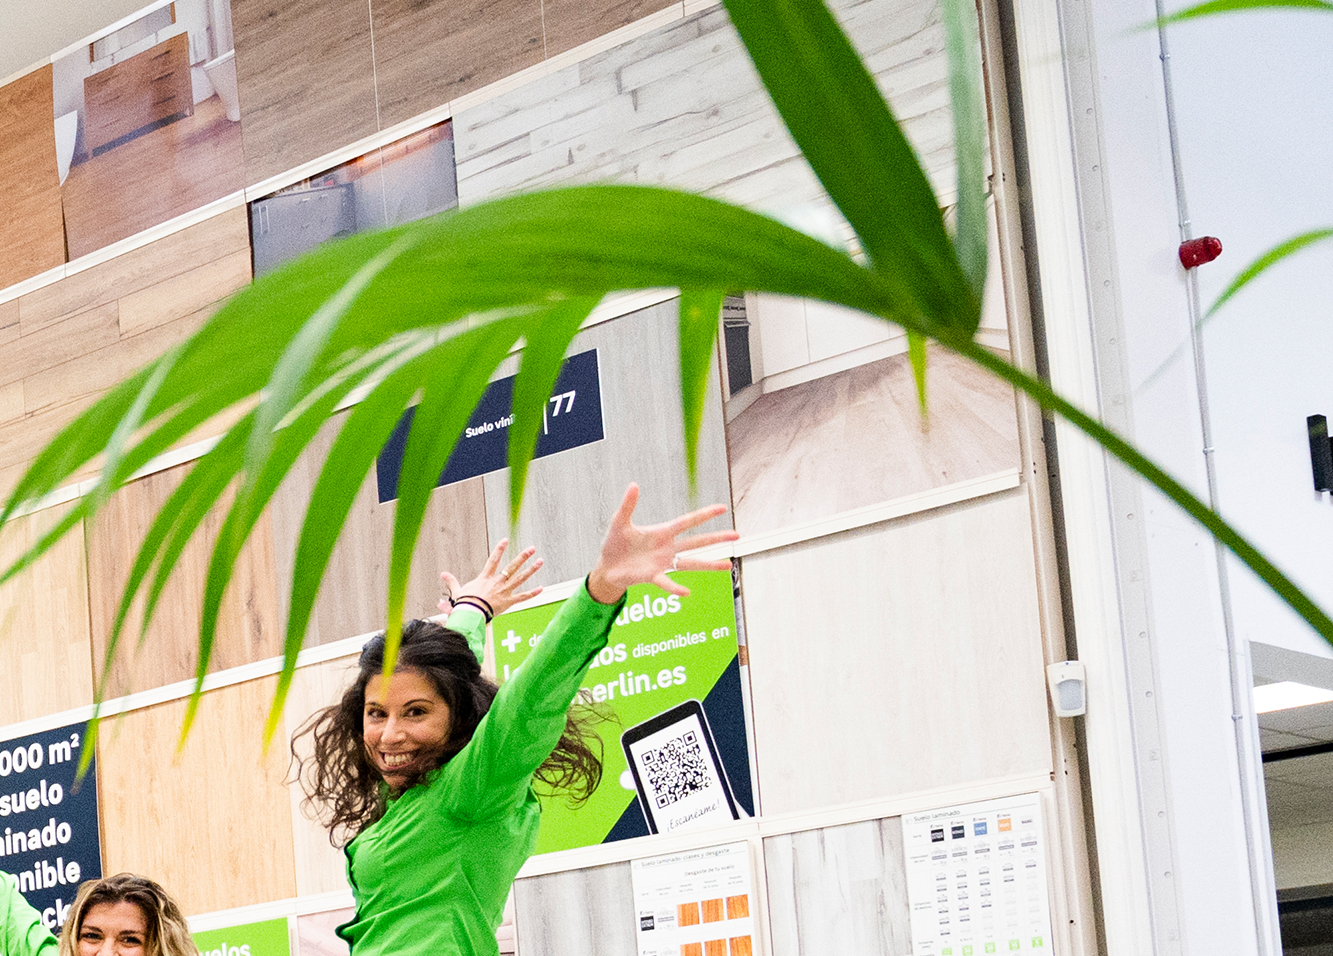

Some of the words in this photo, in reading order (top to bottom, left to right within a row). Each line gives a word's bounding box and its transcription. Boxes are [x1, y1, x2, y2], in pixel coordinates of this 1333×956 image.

[465, 422, 494, 438] Suelo
[549, 390, 576, 417] 77
[615, 594, 681, 626] uelos
[632, 630, 706, 658] disponibles
[712, 626, 730, 639] en
